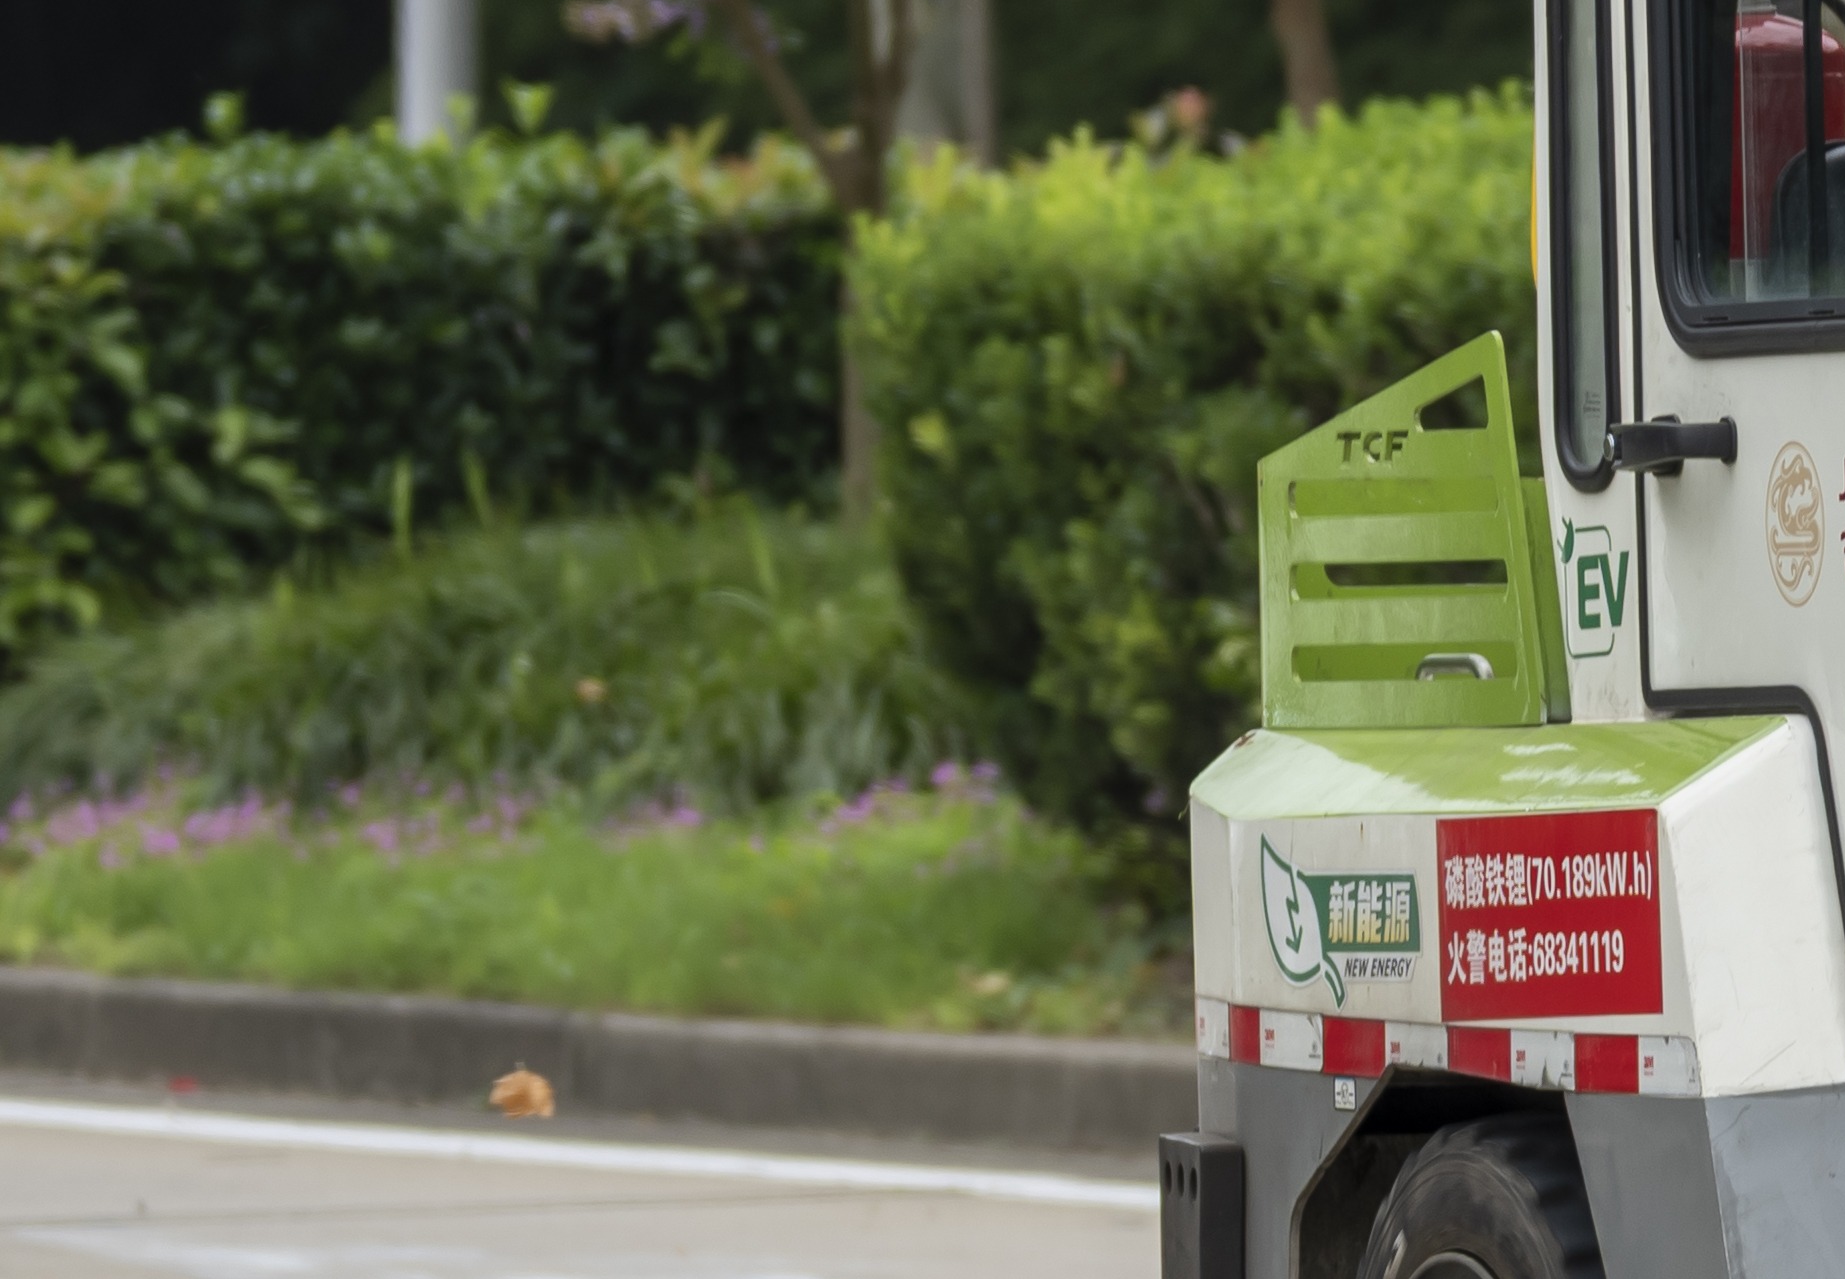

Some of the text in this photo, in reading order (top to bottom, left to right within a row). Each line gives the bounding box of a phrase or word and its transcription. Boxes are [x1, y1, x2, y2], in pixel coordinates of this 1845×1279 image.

[1336, 430, 1409, 464] TCF
[1577, 551, 1630, 631] EV
[1444, 851, 1652, 910] 磷酸铁锂(70.189kW.h)
[1328, 880, 1411, 944] 新能源
[1344, 958, 1412, 978] NEW ENERGY
[1447, 927, 1625, 985] 火警电话:68341119
